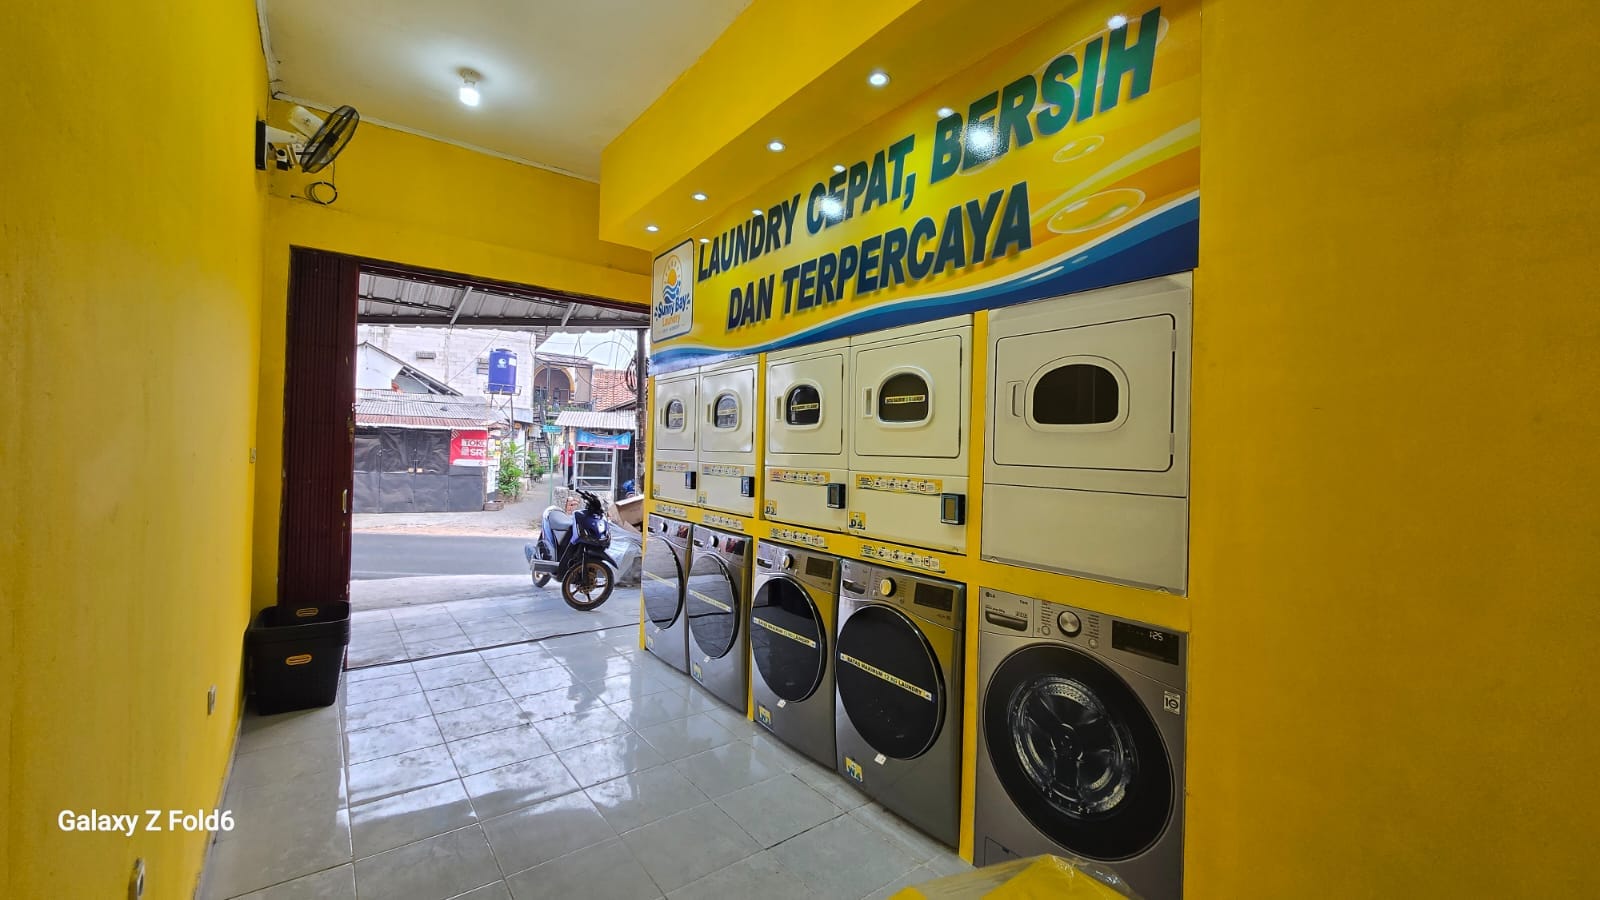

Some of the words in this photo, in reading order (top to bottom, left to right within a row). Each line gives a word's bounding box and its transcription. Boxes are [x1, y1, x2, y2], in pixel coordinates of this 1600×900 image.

[698, 193, 802, 282] LAUNDRY
[807, 133, 917, 235] CEPAT,
[929, 6, 1161, 185] BERSIH
[658, 301, 675, 318] Sunny
[675, 294, 687, 312] Bay
[727, 274, 775, 330] DAN
[780, 181, 1032, 314] TERPERCAYA
